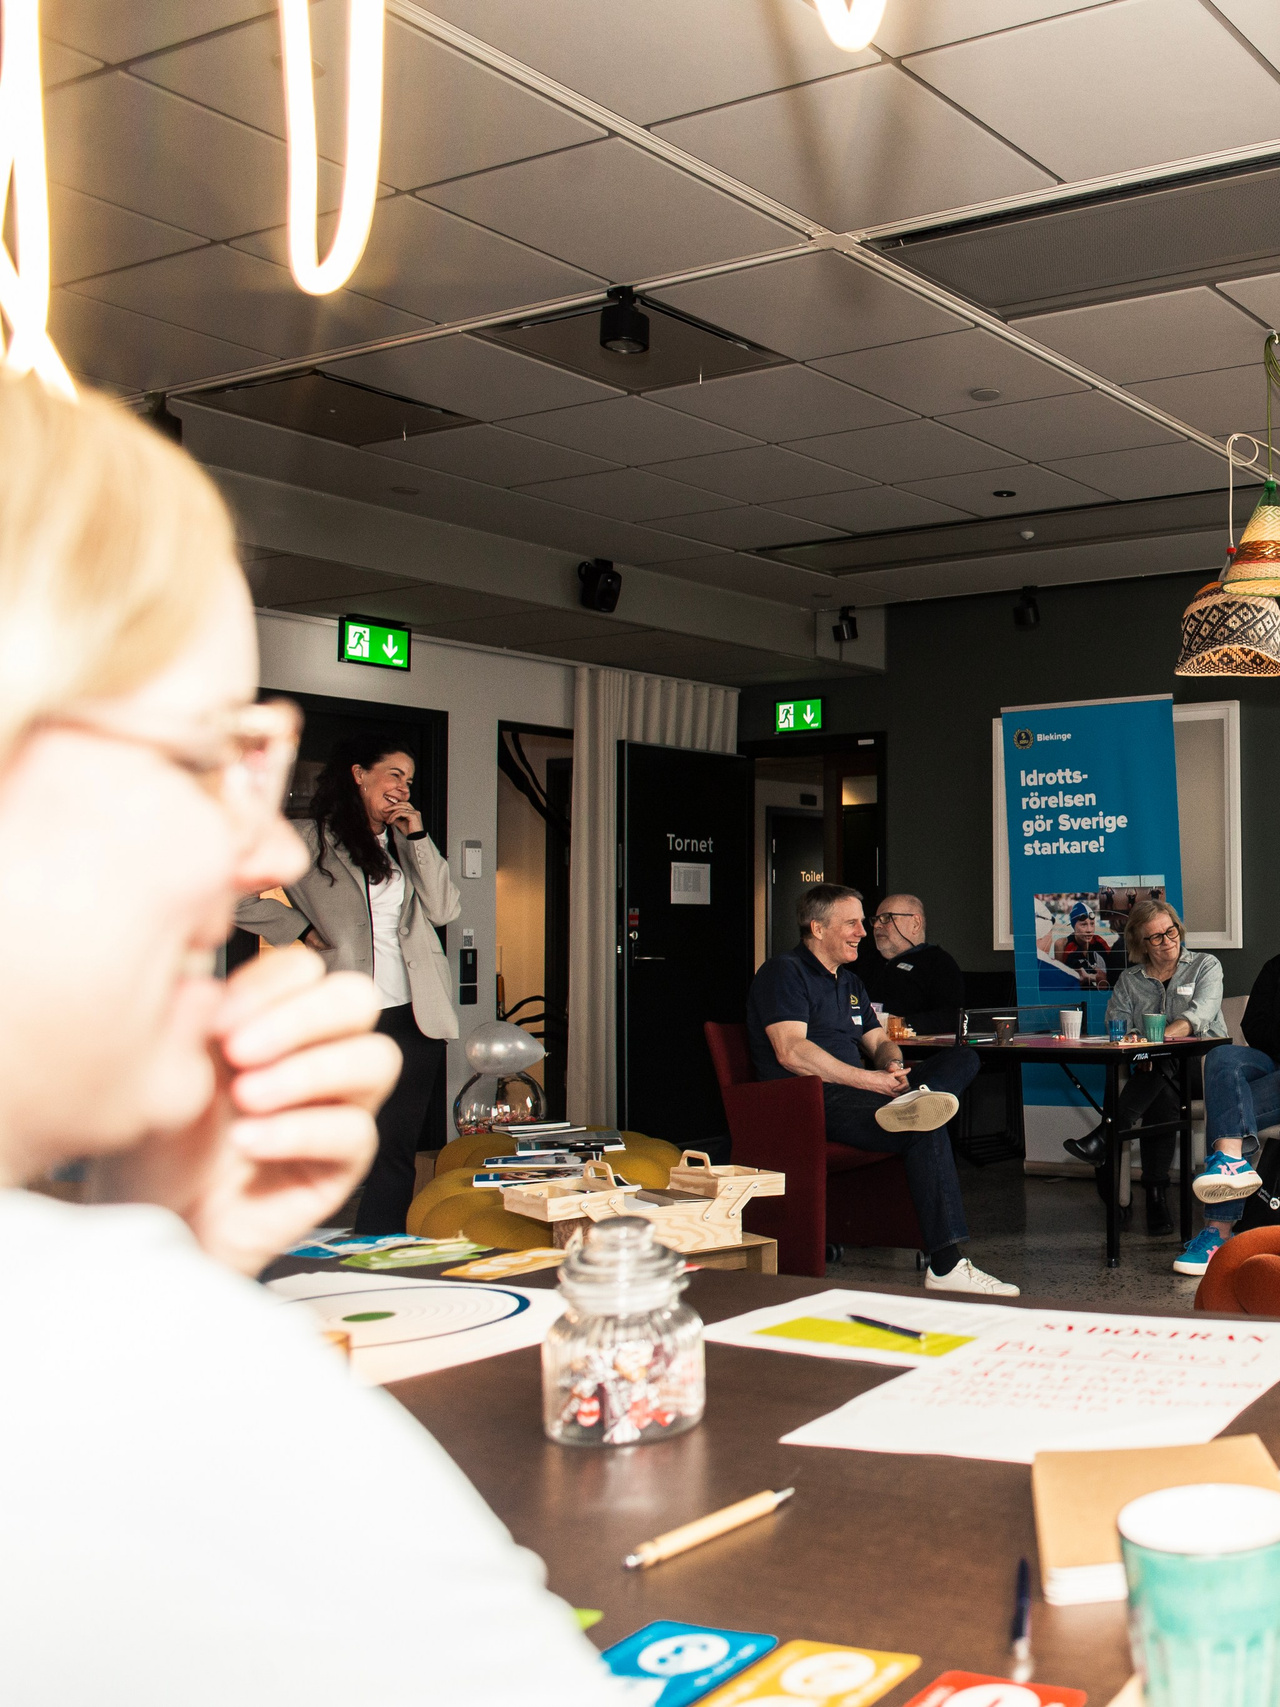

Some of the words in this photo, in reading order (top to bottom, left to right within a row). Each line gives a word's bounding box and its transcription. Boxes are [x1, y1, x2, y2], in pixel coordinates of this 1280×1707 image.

[1036, 732, 1072, 742] Blekinge
[1020, 769, 1089, 787] Idrotts-
[1021, 791, 1097, 810] rörelsen
[1022, 814, 1053, 837] gör
[1058, 811, 1128, 833] Sverige
[666, 833, 714, 853] Tornet
[1023, 836, 1105, 856] starkare!
